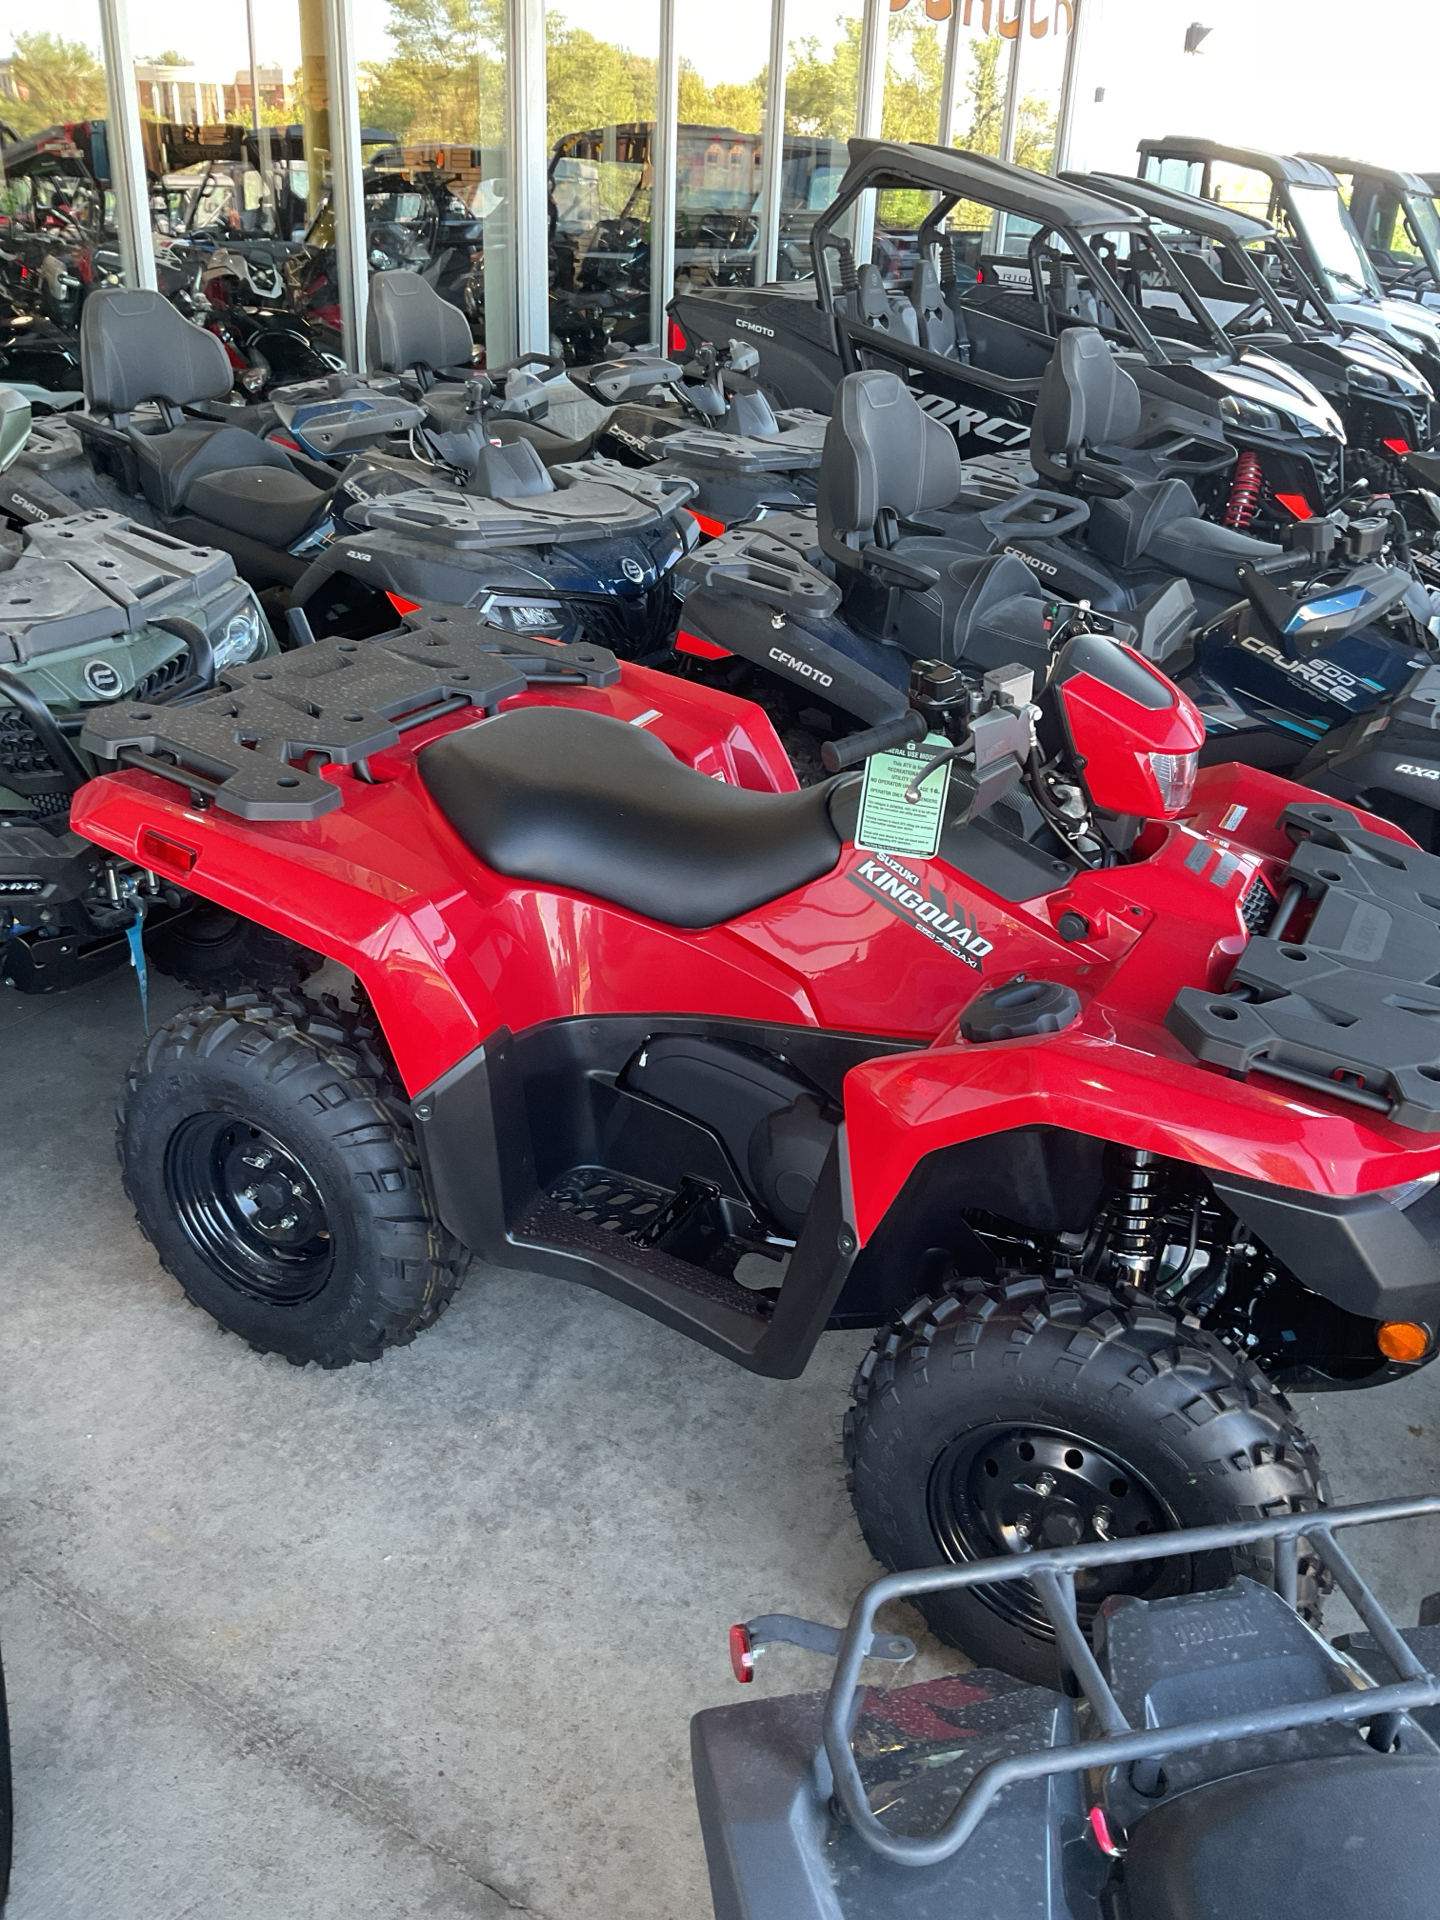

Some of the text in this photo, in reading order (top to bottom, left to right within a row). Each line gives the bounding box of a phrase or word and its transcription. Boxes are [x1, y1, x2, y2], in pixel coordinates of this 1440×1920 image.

[735, 318, 775, 338] CFMOTO
[11, 493, 50, 521] CFMOTO
[768, 647, 834, 688] CFMOTO
[1240, 636, 1358, 703] CFORCE
[1308, 658, 1357, 687] 600
[907, 751, 919, 759] USE
[876, 852, 921, 886] SUZUKI
[857, 859, 994, 957] KINGQUAD
